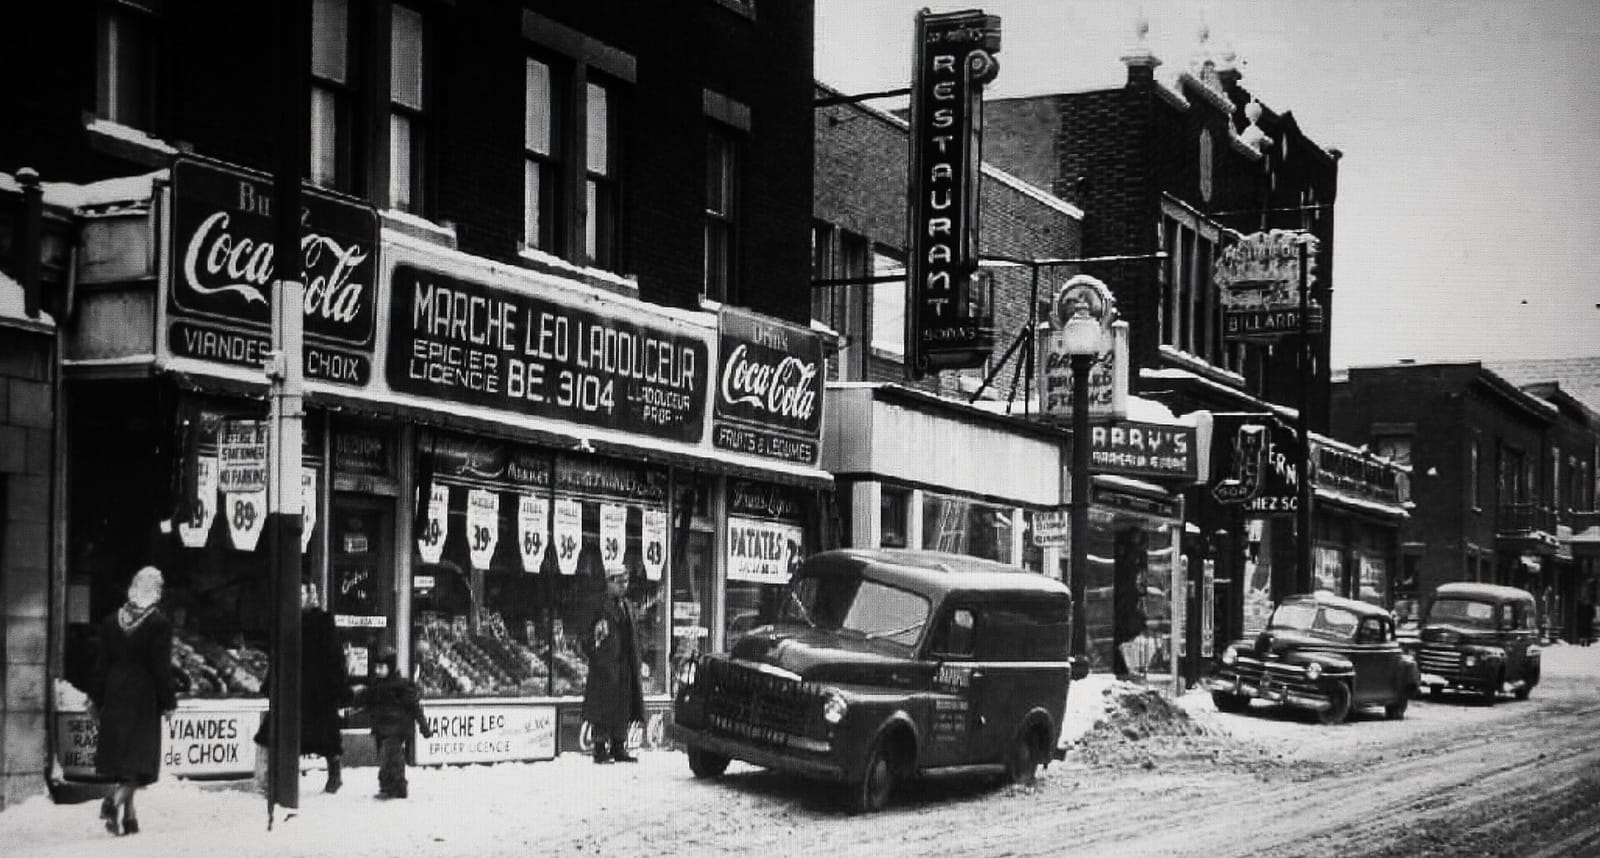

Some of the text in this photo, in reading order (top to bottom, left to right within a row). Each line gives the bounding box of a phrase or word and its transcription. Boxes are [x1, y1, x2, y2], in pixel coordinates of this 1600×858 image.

[927, 54, 956, 317] RESTAURANT
[238, 182, 312, 228] Buz
[185, 327, 359, 382] VIANDES CHOIX
[414, 280, 695, 392] MARCHE LEO LADOUCEUR
[413, 338, 499, 375] EPICIER
[722, 344, 816, 420] Coca-Cola
[1092, 427, 1187, 453] ARRY'S
[1281, 496, 1299, 511] SC
[730, 527, 782, 561] PATATES
[168, 719, 237, 741] VIANDES
[165, 743, 239, 766] de CHOIX
